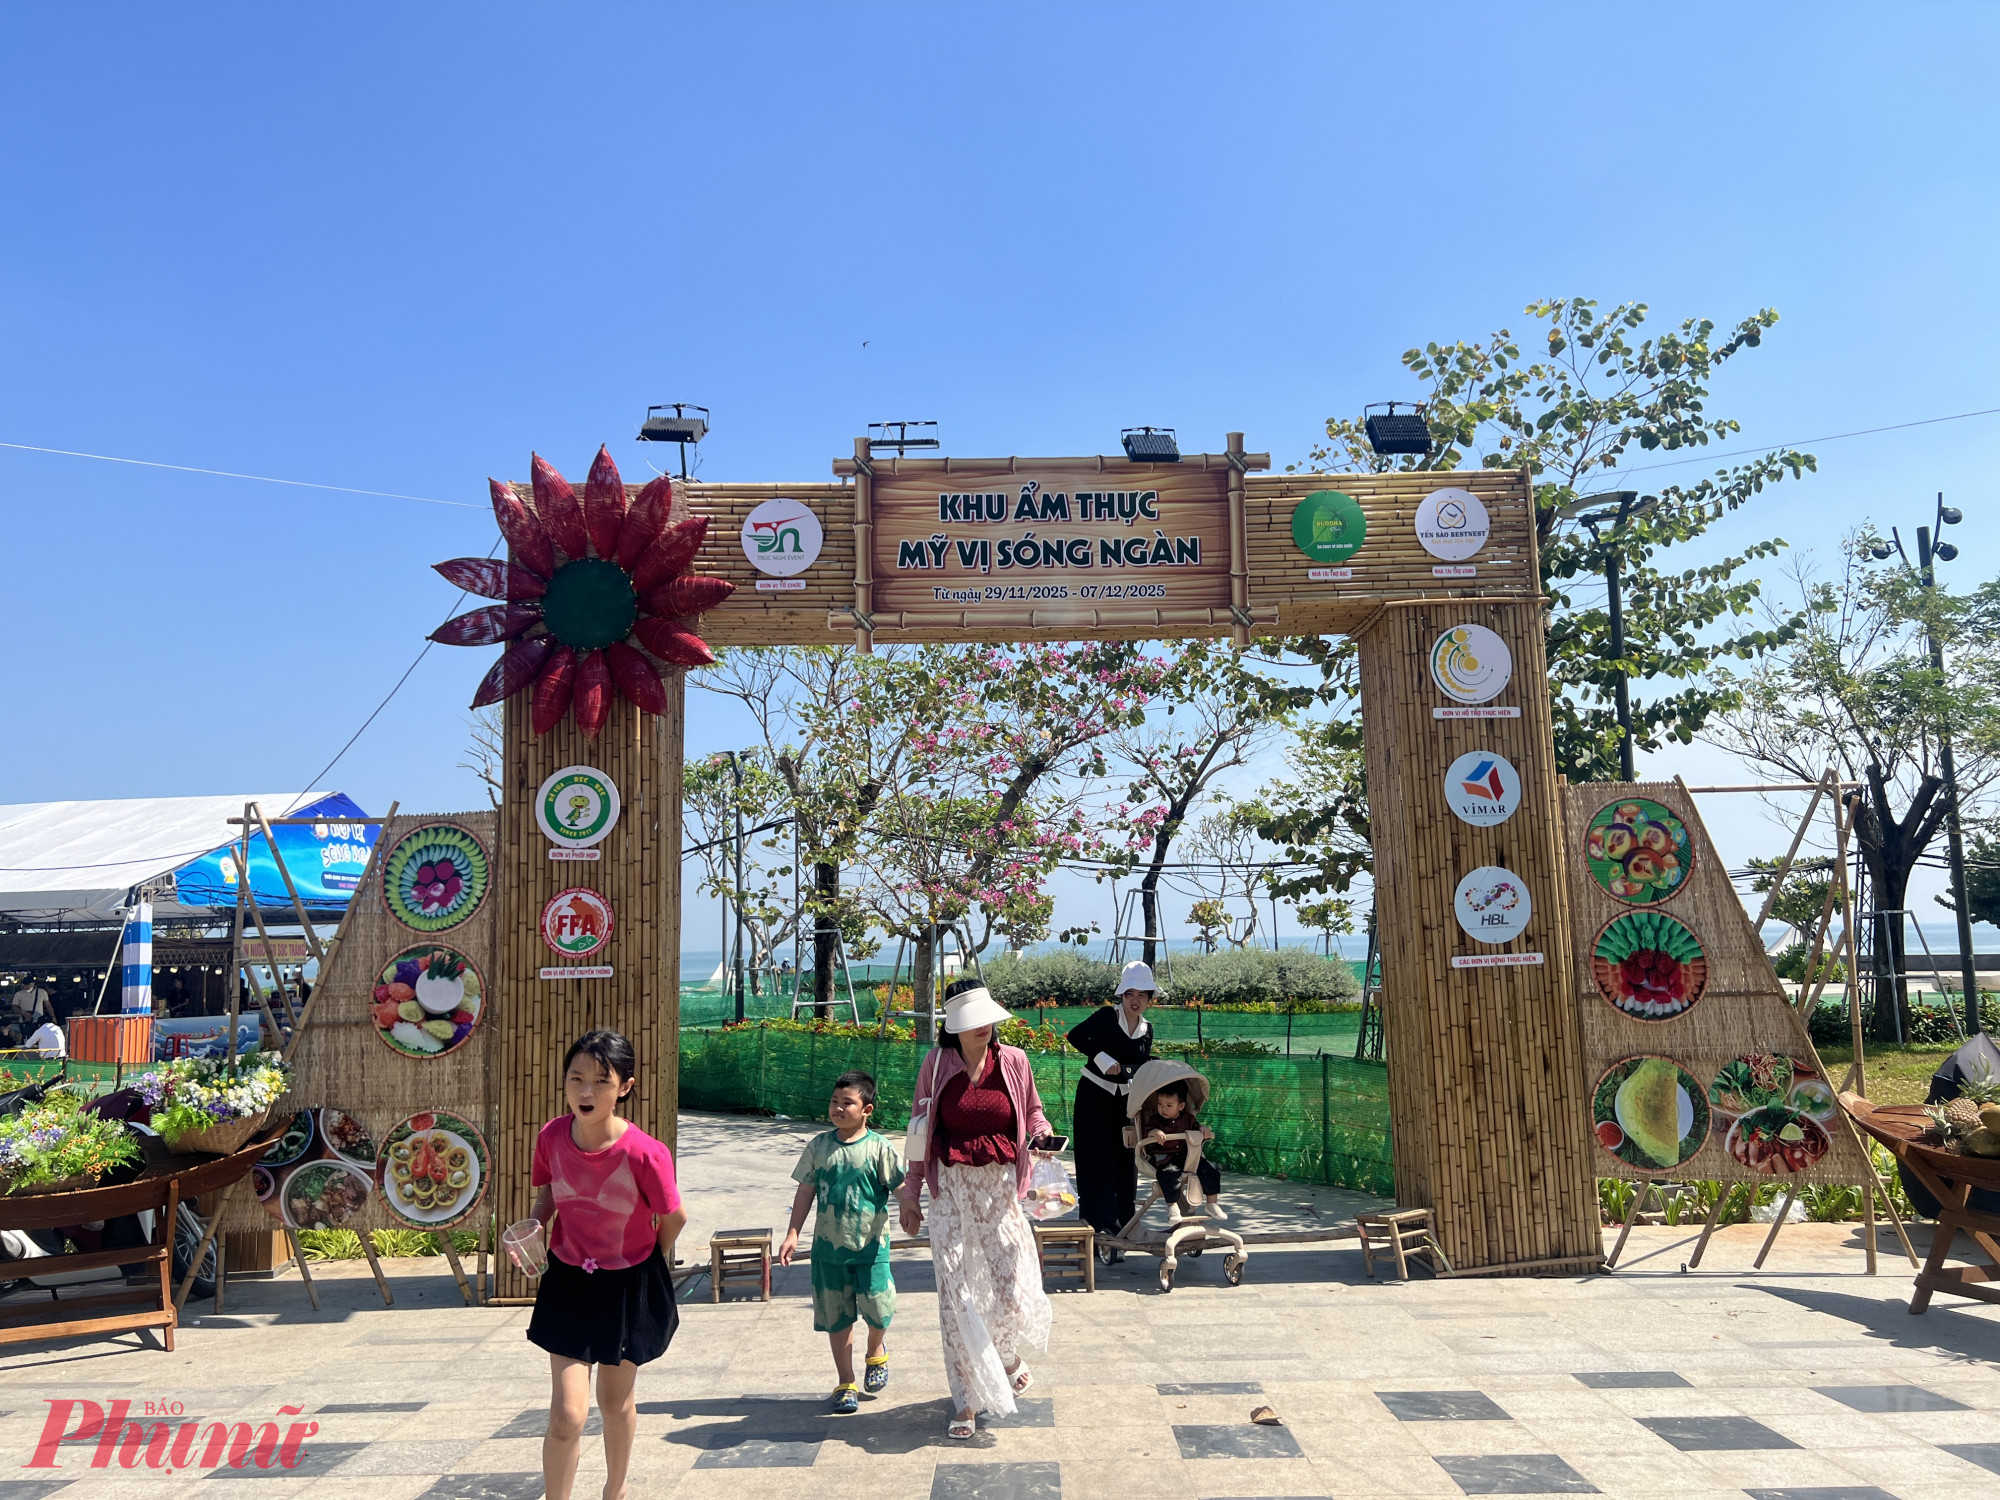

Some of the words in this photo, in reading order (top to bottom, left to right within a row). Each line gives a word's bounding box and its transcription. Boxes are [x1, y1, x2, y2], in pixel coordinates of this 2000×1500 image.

[939, 492, 1006, 522] KHU
[1014, 481, 1070, 521] ẨM
[1076, 490, 1158, 525] THỰC
[1420, 530, 1434, 538] YẾN
[898, 534, 948, 569] MỸ
[956, 538, 990, 573] VỊ
[997, 532, 1092, 568] SÓNG
[1100, 530, 1200, 566] NGÀN
[932, 586, 950, 600] Từ
[950, 587, 982, 604] ngày
[985, 586, 1068, 601] 29/11/2025
[1080, 584, 1166, 599] 07/12/2025
[558, 915, 596, 936] FFA
[1481, 914, 1509, 925] HBL
